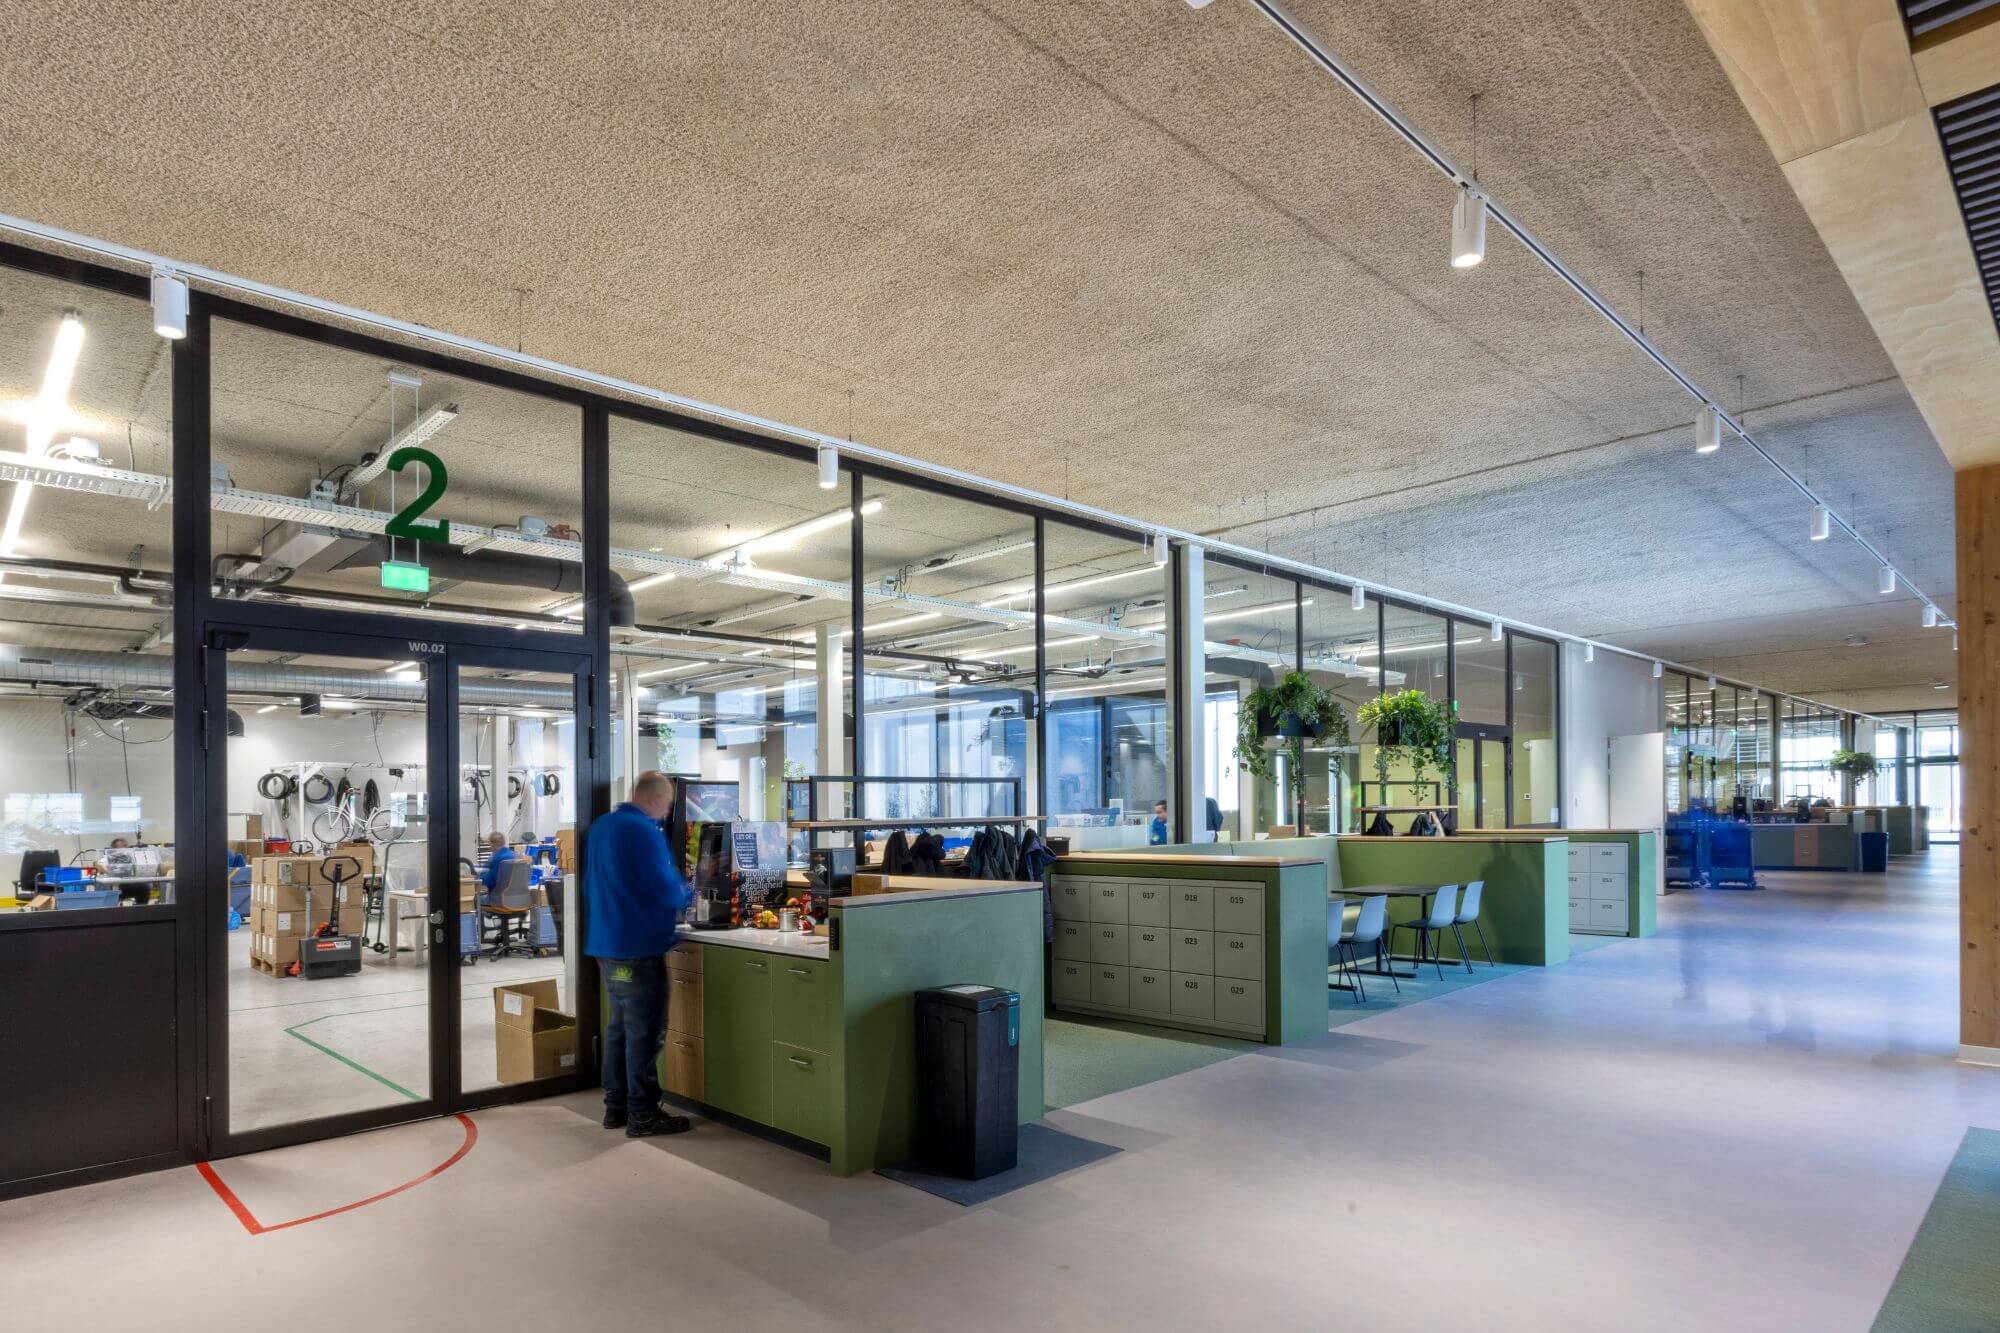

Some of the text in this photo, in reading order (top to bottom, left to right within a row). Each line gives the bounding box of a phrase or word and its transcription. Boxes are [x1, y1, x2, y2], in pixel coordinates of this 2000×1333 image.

[385, 447, 450, 544] 2
[408, 641, 446, 654] W0.02
[1184, 894, 1198, 902] 018
[1229, 896, 1244, 904] 019
[1142, 934, 1155, 942] 022
[1184, 937, 1198, 945] 023
[1229, 941, 1244, 949] 024
[1142, 976, 1155, 984] 027
[1184, 980, 1199, 989] 028
[1229, 986, 1244, 995] 029
